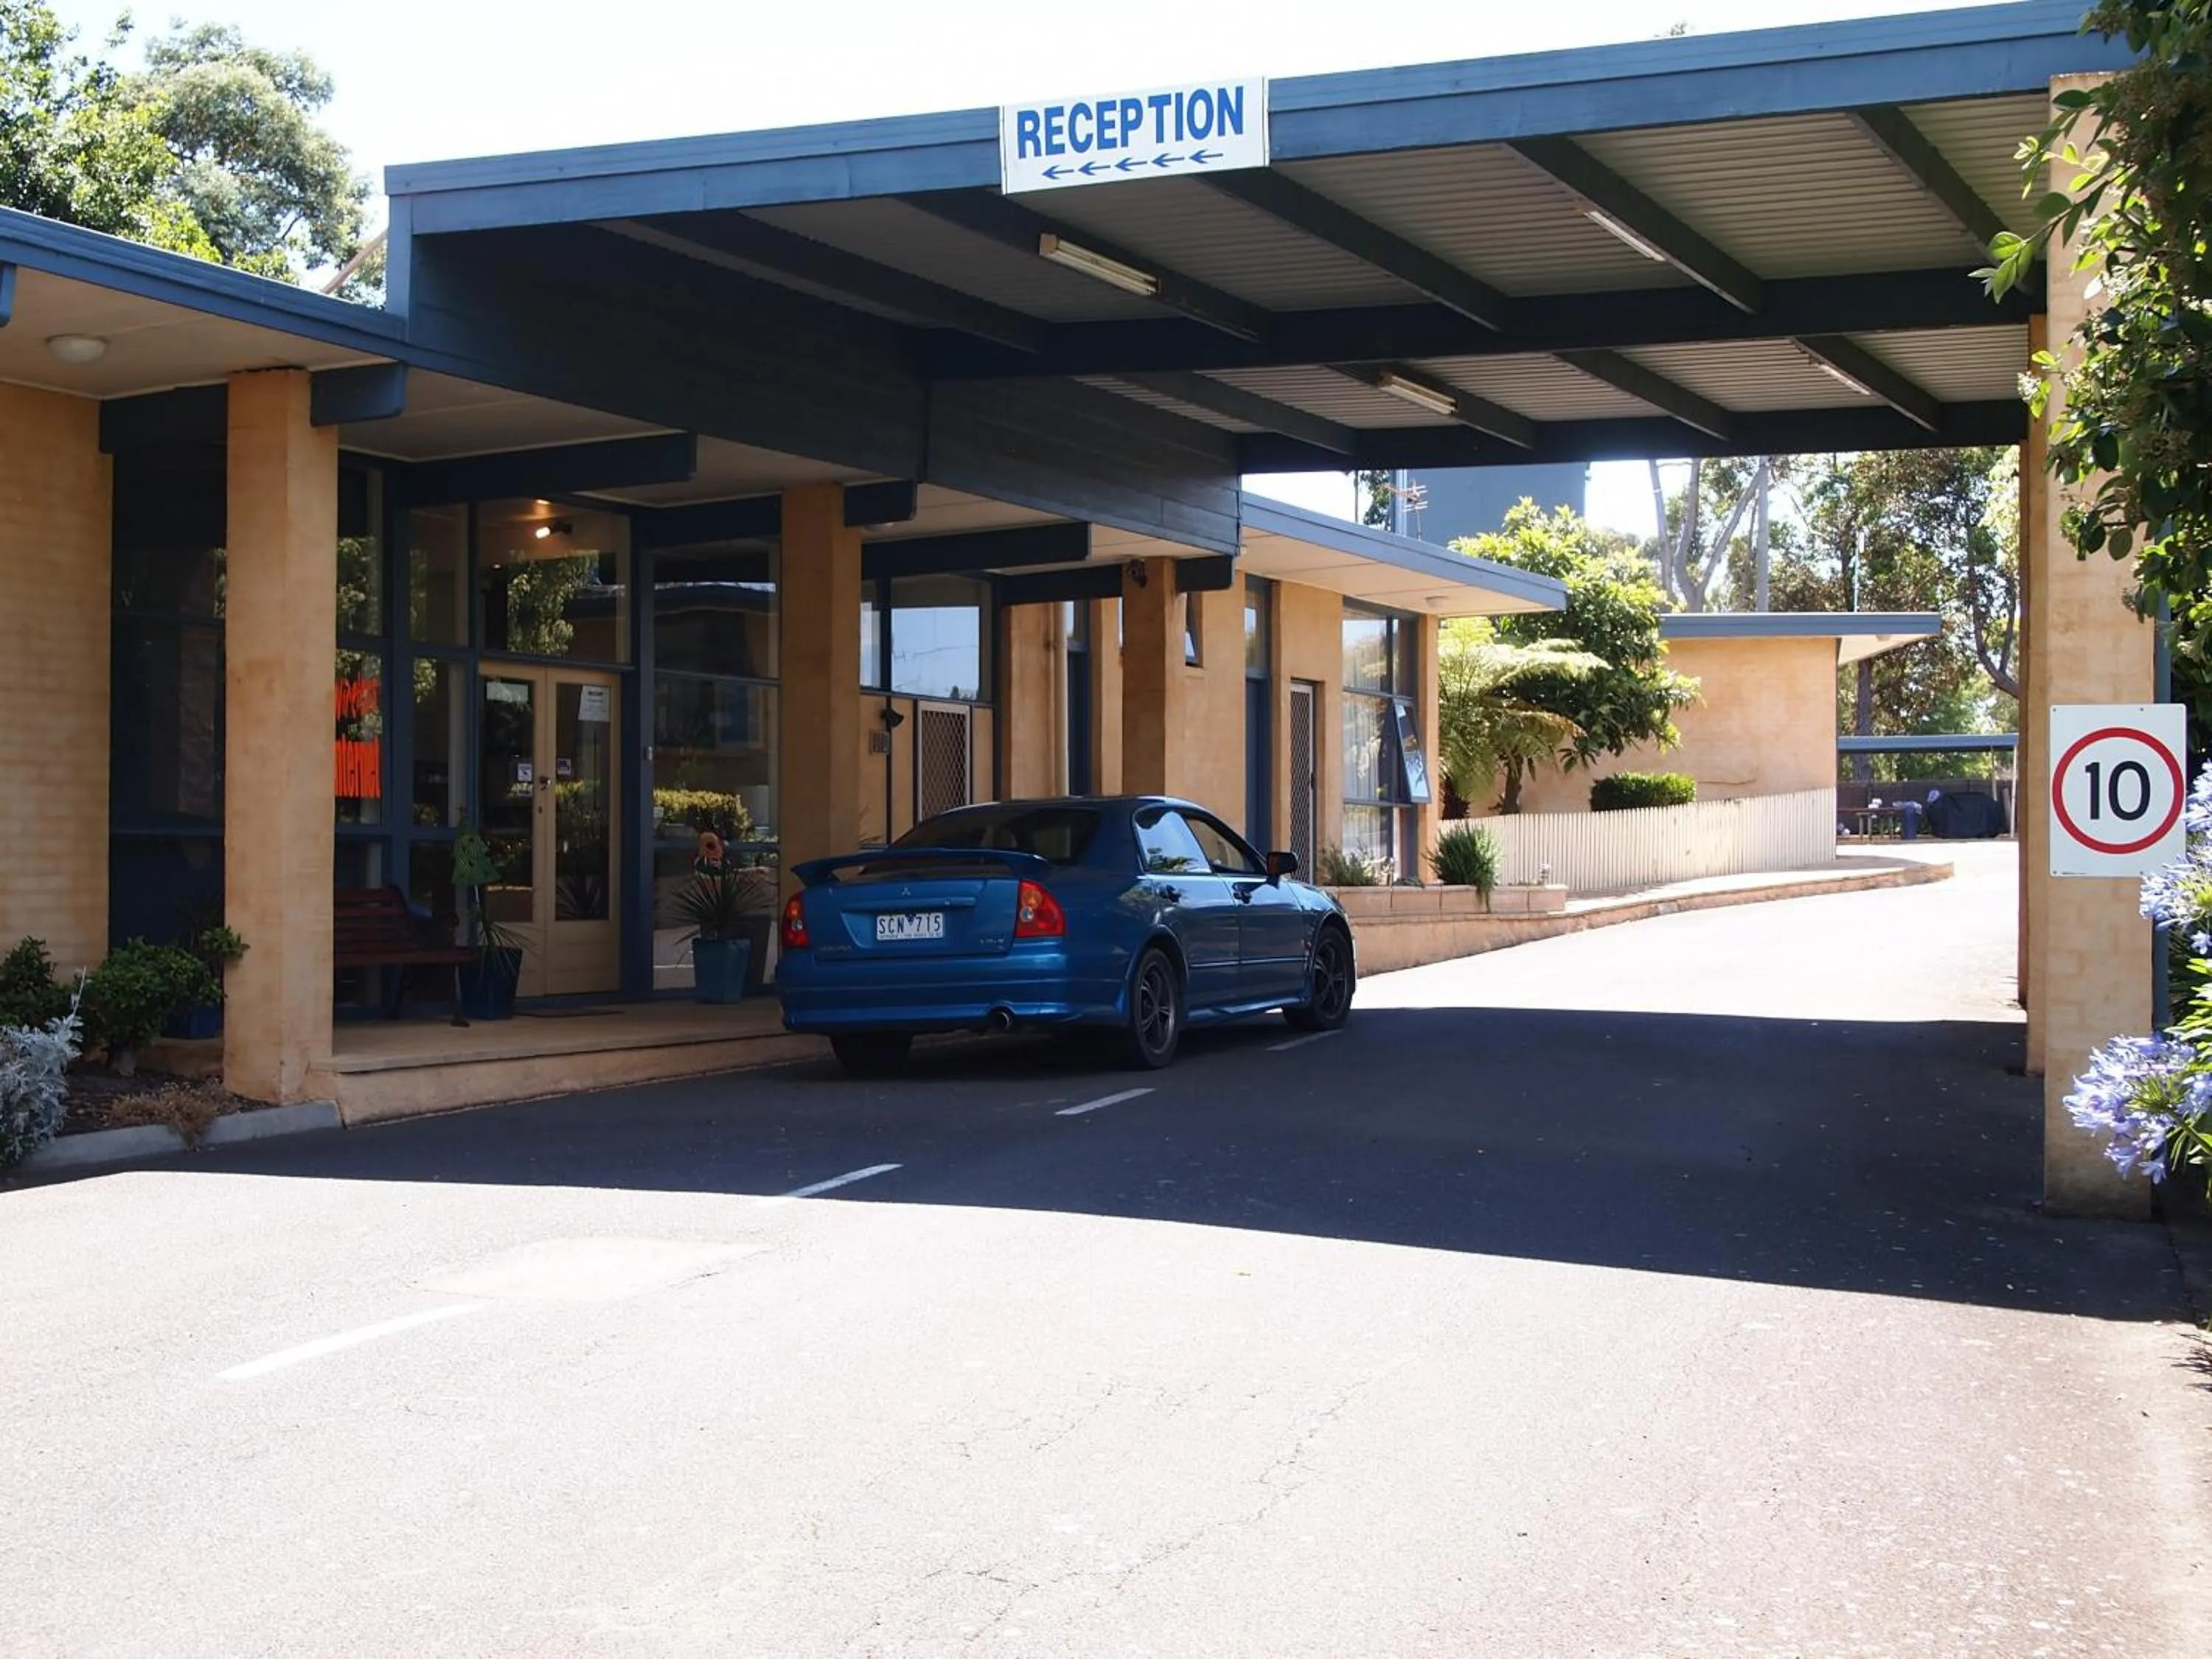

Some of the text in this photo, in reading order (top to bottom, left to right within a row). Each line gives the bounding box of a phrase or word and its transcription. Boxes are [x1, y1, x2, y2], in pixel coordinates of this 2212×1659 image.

[1017, 86, 1244, 159] RECEPTION
[2084, 760, 2151, 821] 10
[878, 915, 940, 934] SCN 715
